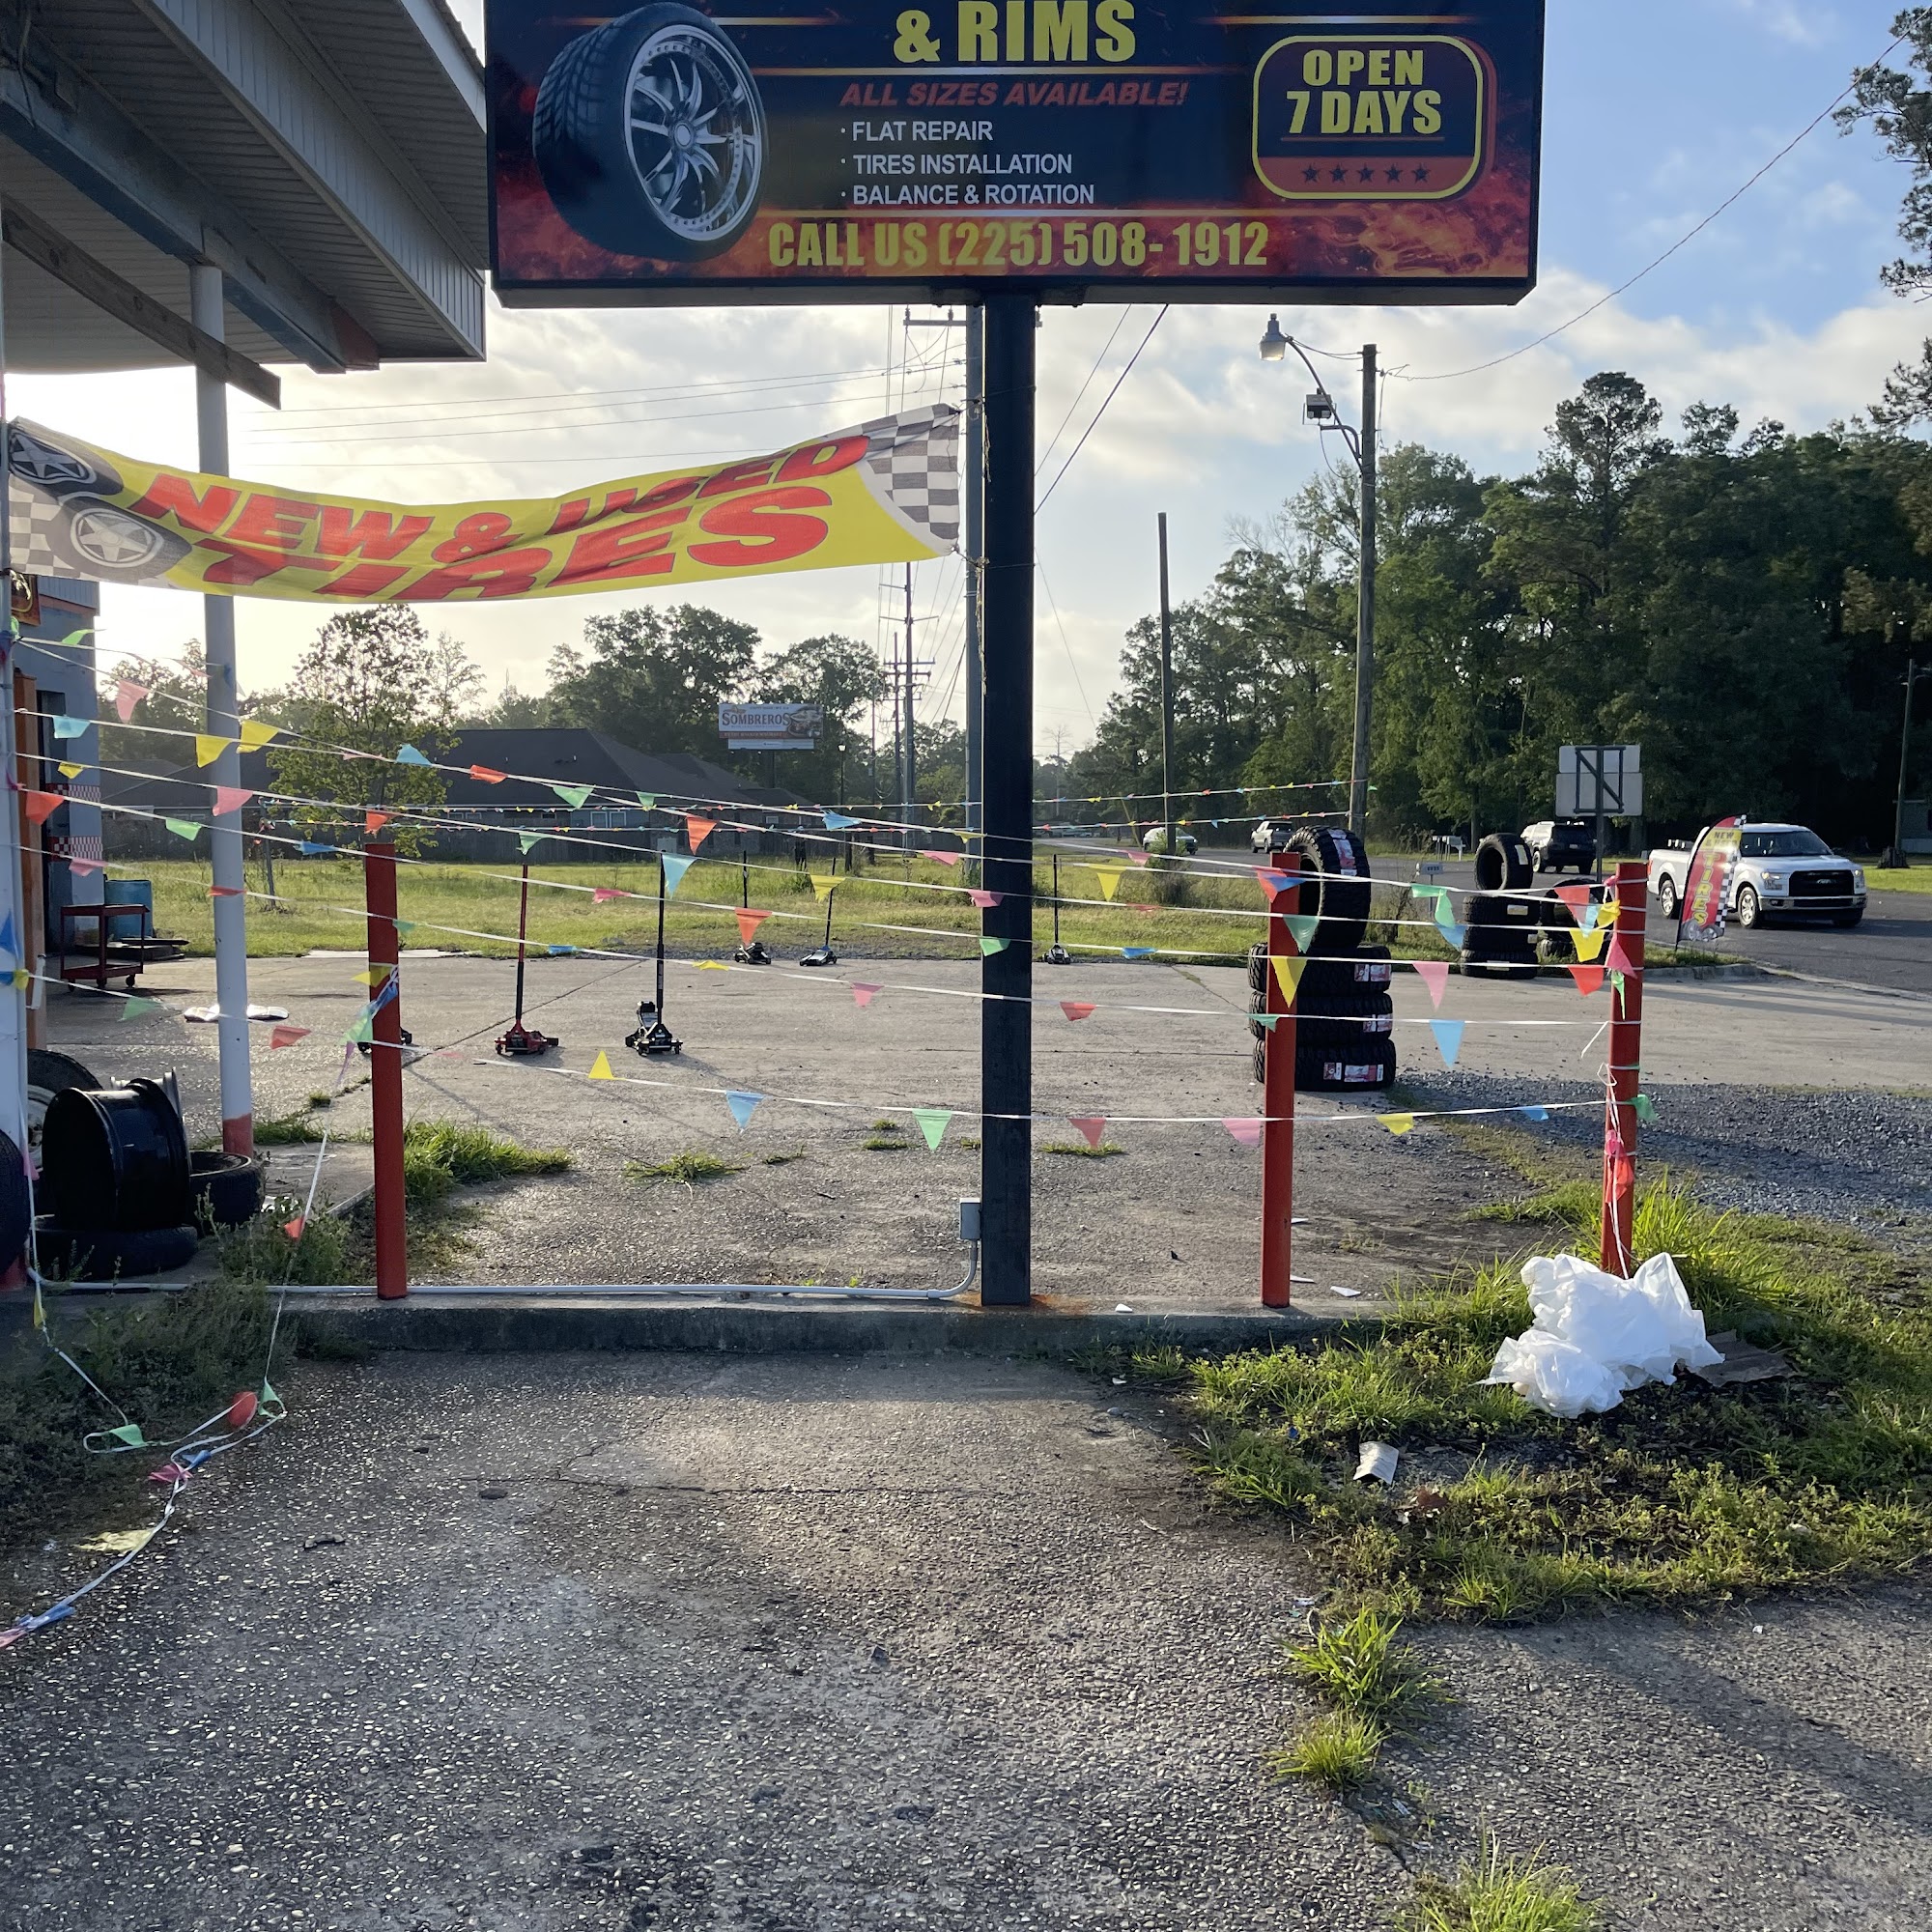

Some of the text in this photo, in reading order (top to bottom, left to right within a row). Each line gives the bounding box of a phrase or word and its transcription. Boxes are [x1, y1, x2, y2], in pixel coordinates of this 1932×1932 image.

[894, 0, 1136, 63] & RIMS
[1302, 49, 1425, 87] OPEN
[839, 81, 1189, 106] ALL SIZES AVAILABLE!
[1286, 90, 1442, 134] 7 DAYS
[852, 121, 994, 142] FLAT REPAIR
[852, 154, 1072, 175] TIRES INSTALLATION
[853, 184, 1094, 205] BALANCE & ROTATION
[769, 222, 865, 267] CALL
[874, 222, 927, 267] US
[939, 222, 1052, 267] (225)
[128, 435, 869, 564] NEW & USED
[192, 486, 833, 600] TIRES
[1692, 854, 1719, 924] TIRES
